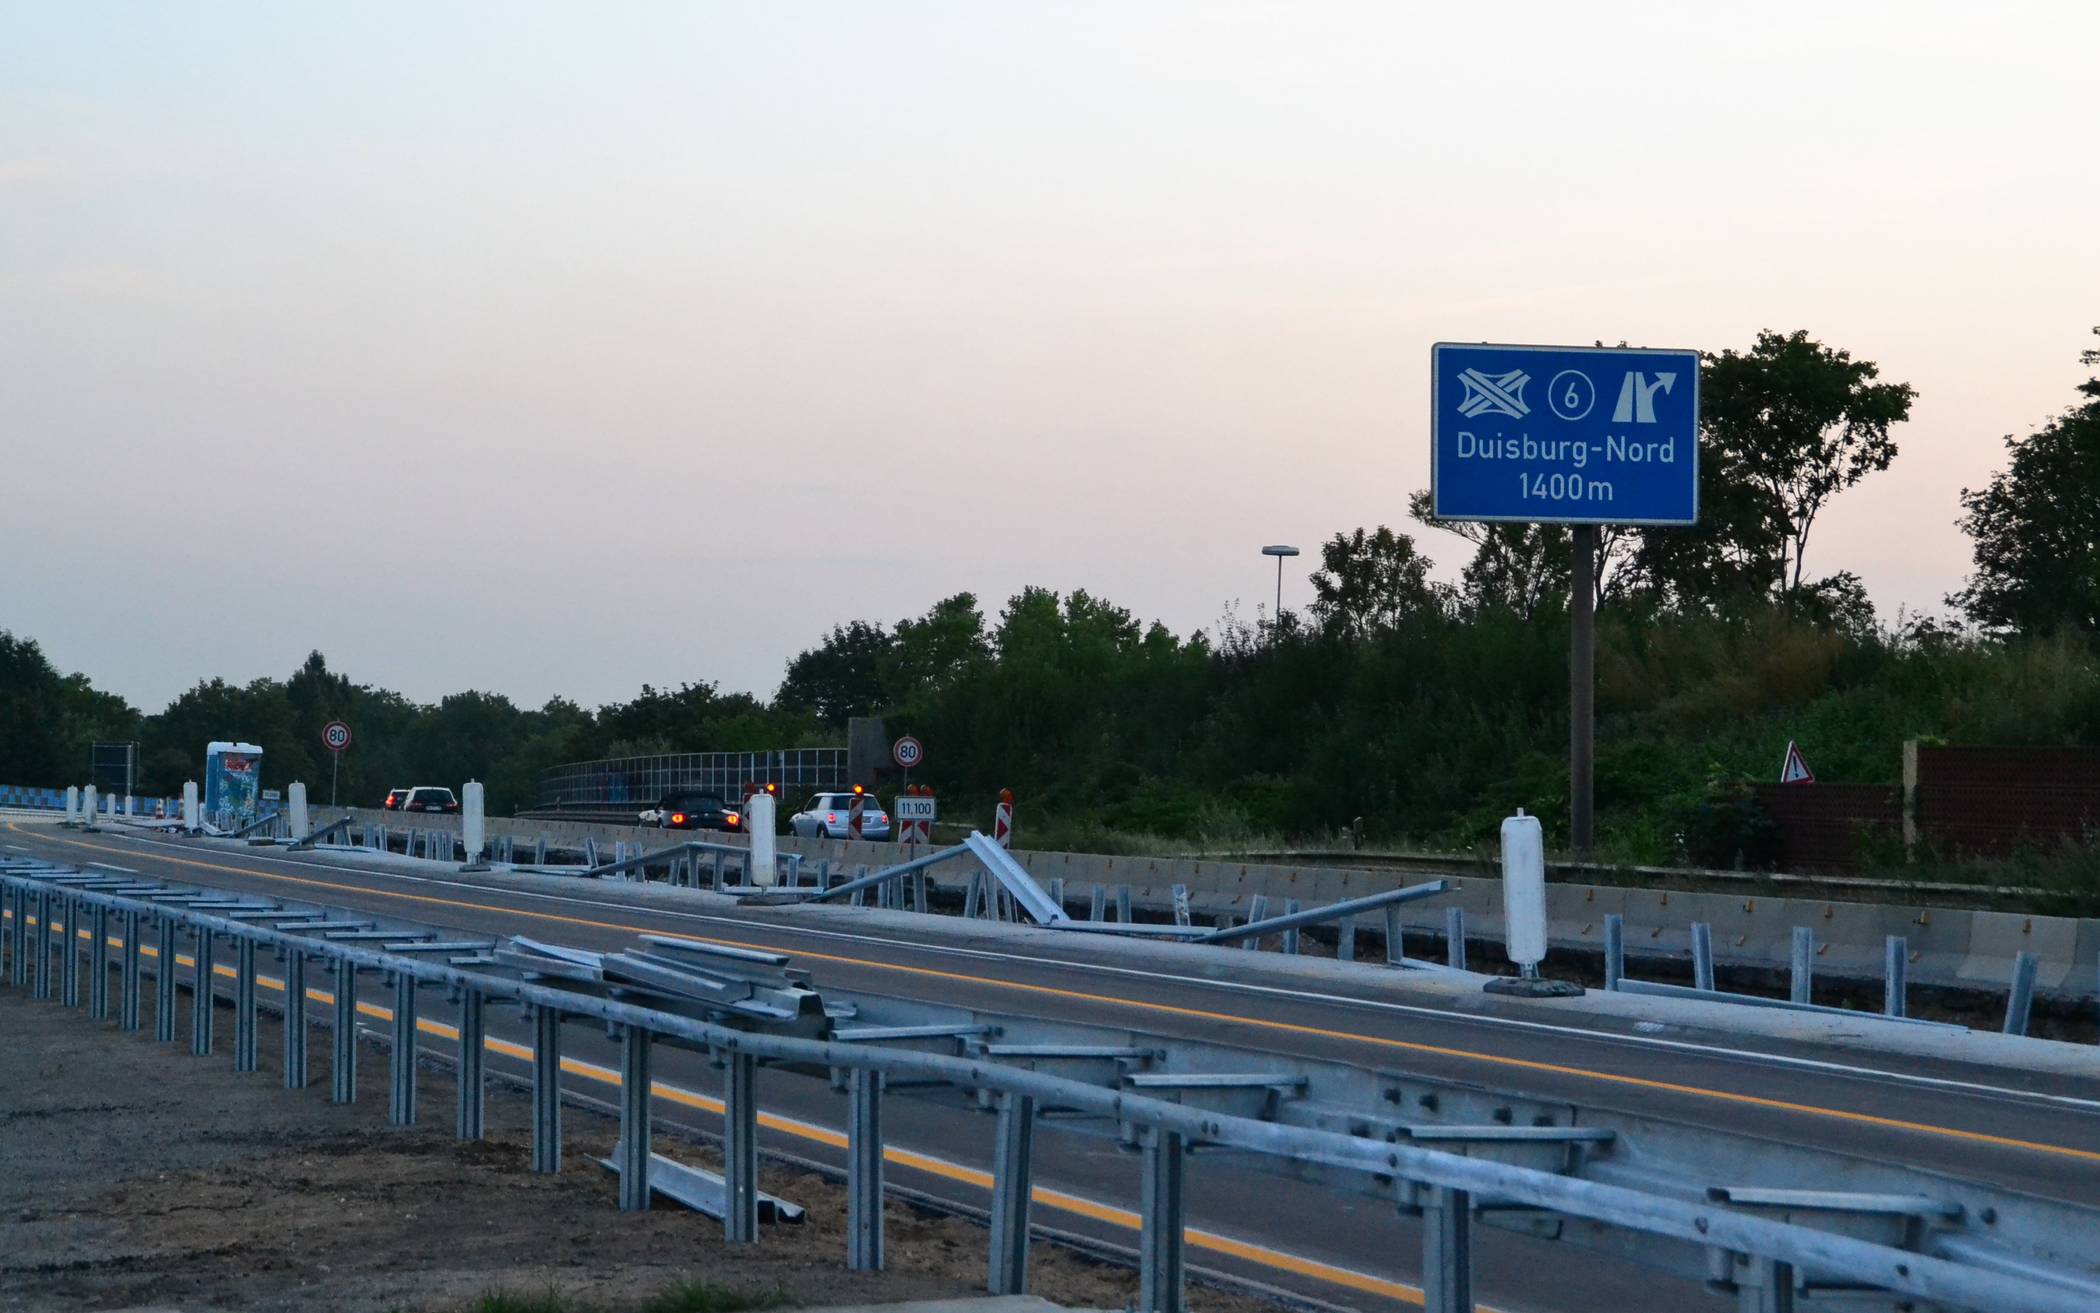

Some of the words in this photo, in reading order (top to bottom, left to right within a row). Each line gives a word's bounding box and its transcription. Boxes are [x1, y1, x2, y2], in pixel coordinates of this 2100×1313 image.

[1564, 382, 1579, 408] 6
[1457, 431, 1674, 468] Duisburg-Nord
[329, 729, 345, 742] 80
[900, 745, 916, 759] 80
